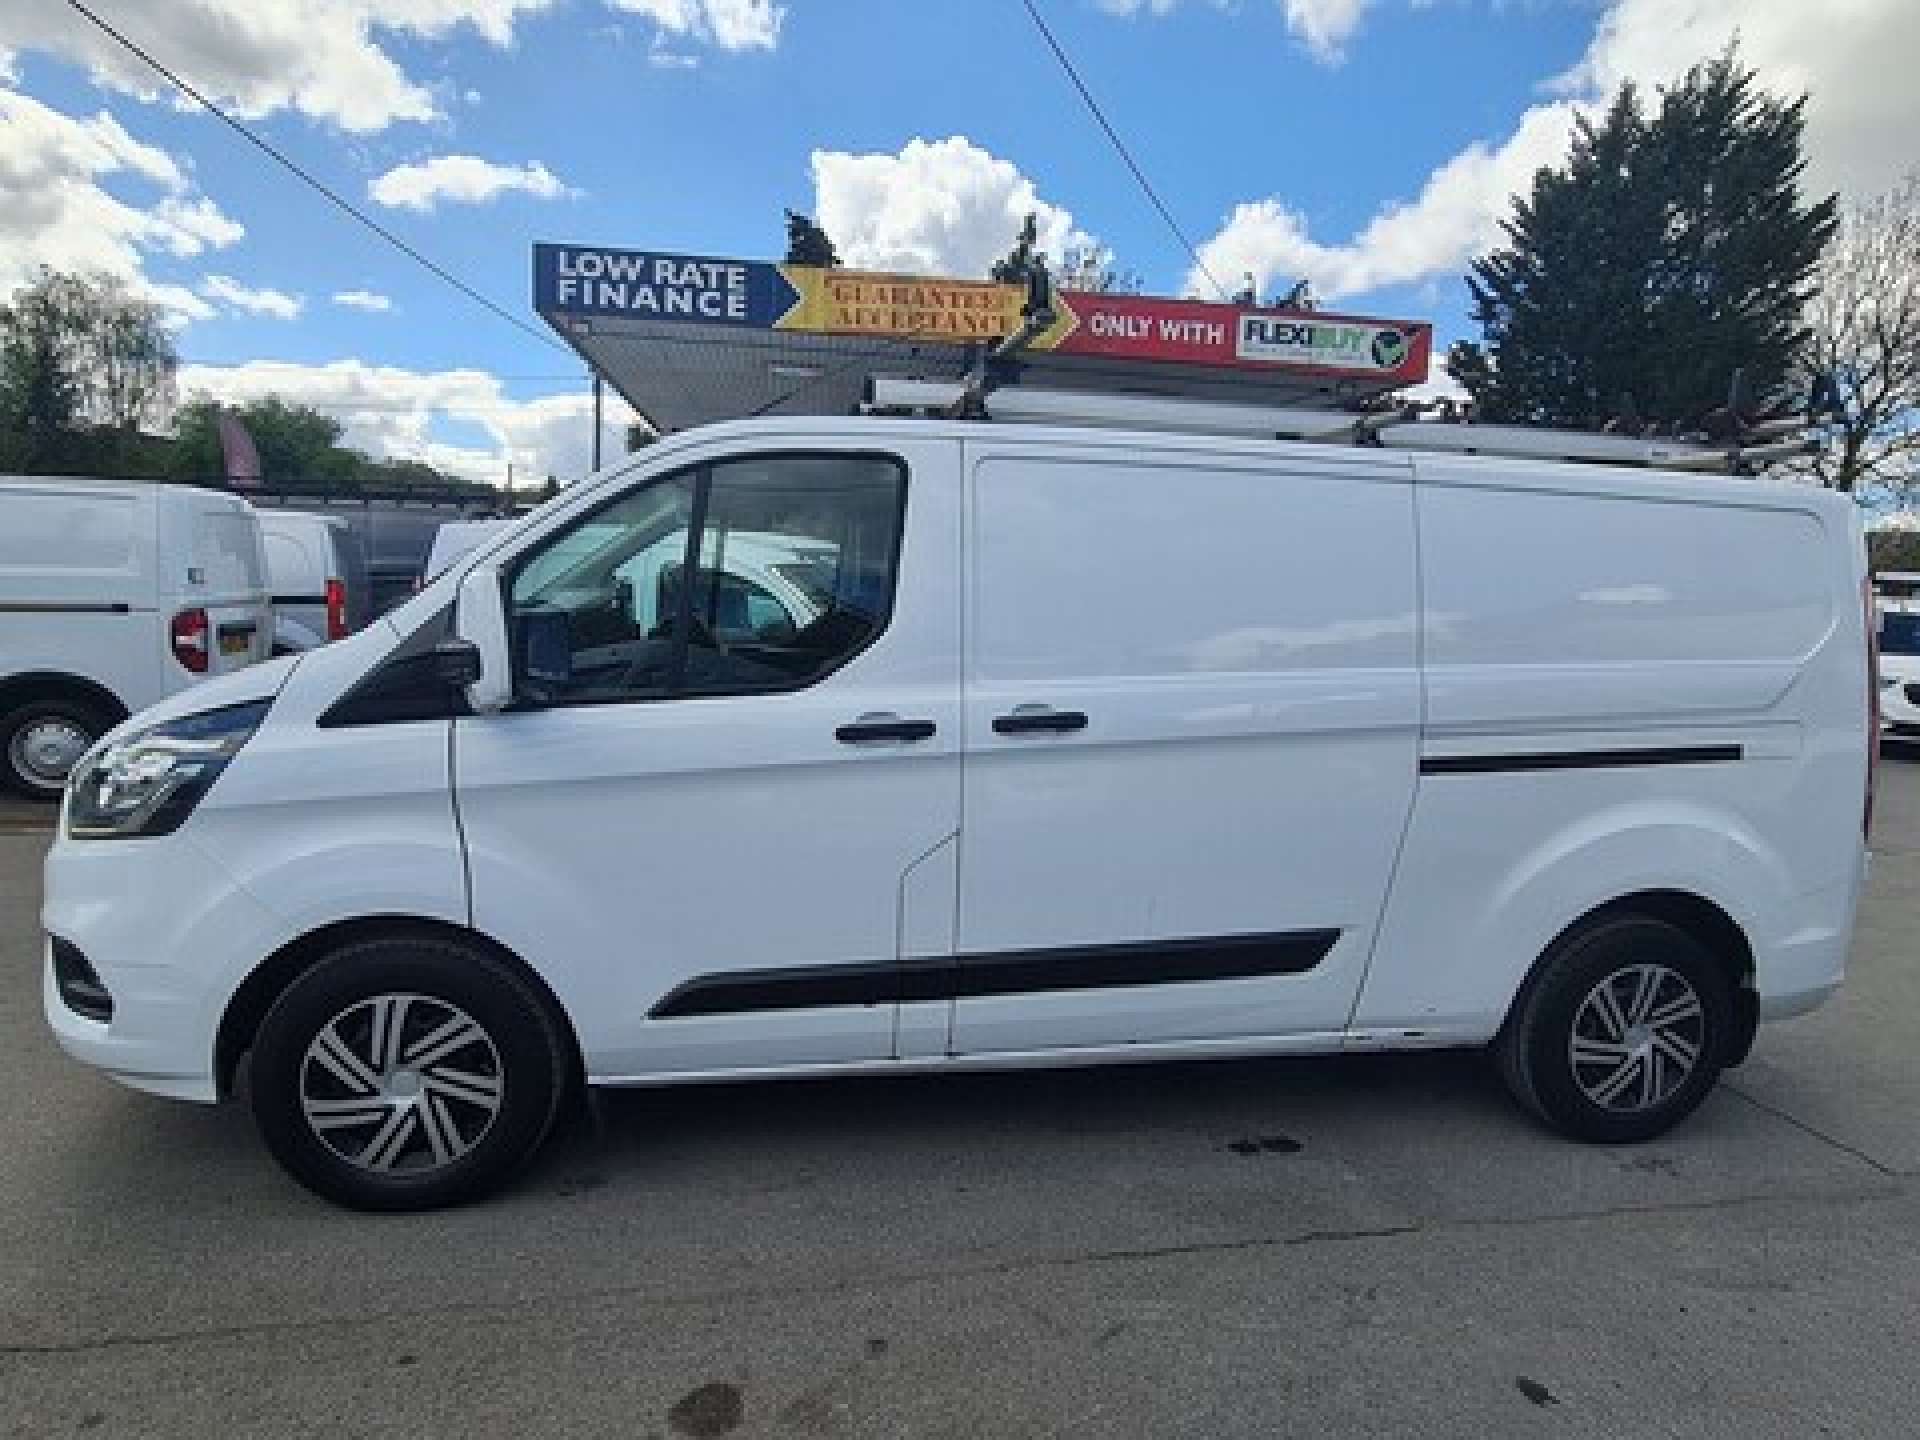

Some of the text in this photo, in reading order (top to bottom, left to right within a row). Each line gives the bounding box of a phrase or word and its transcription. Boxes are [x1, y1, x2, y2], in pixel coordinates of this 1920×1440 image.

[559, 252, 745, 289] LOW RATE
[559, 279, 745, 317] FINANCE
[1091, 313, 1224, 344] ONLY WITH
[1243, 319, 1365, 347] FLEXIBUY
